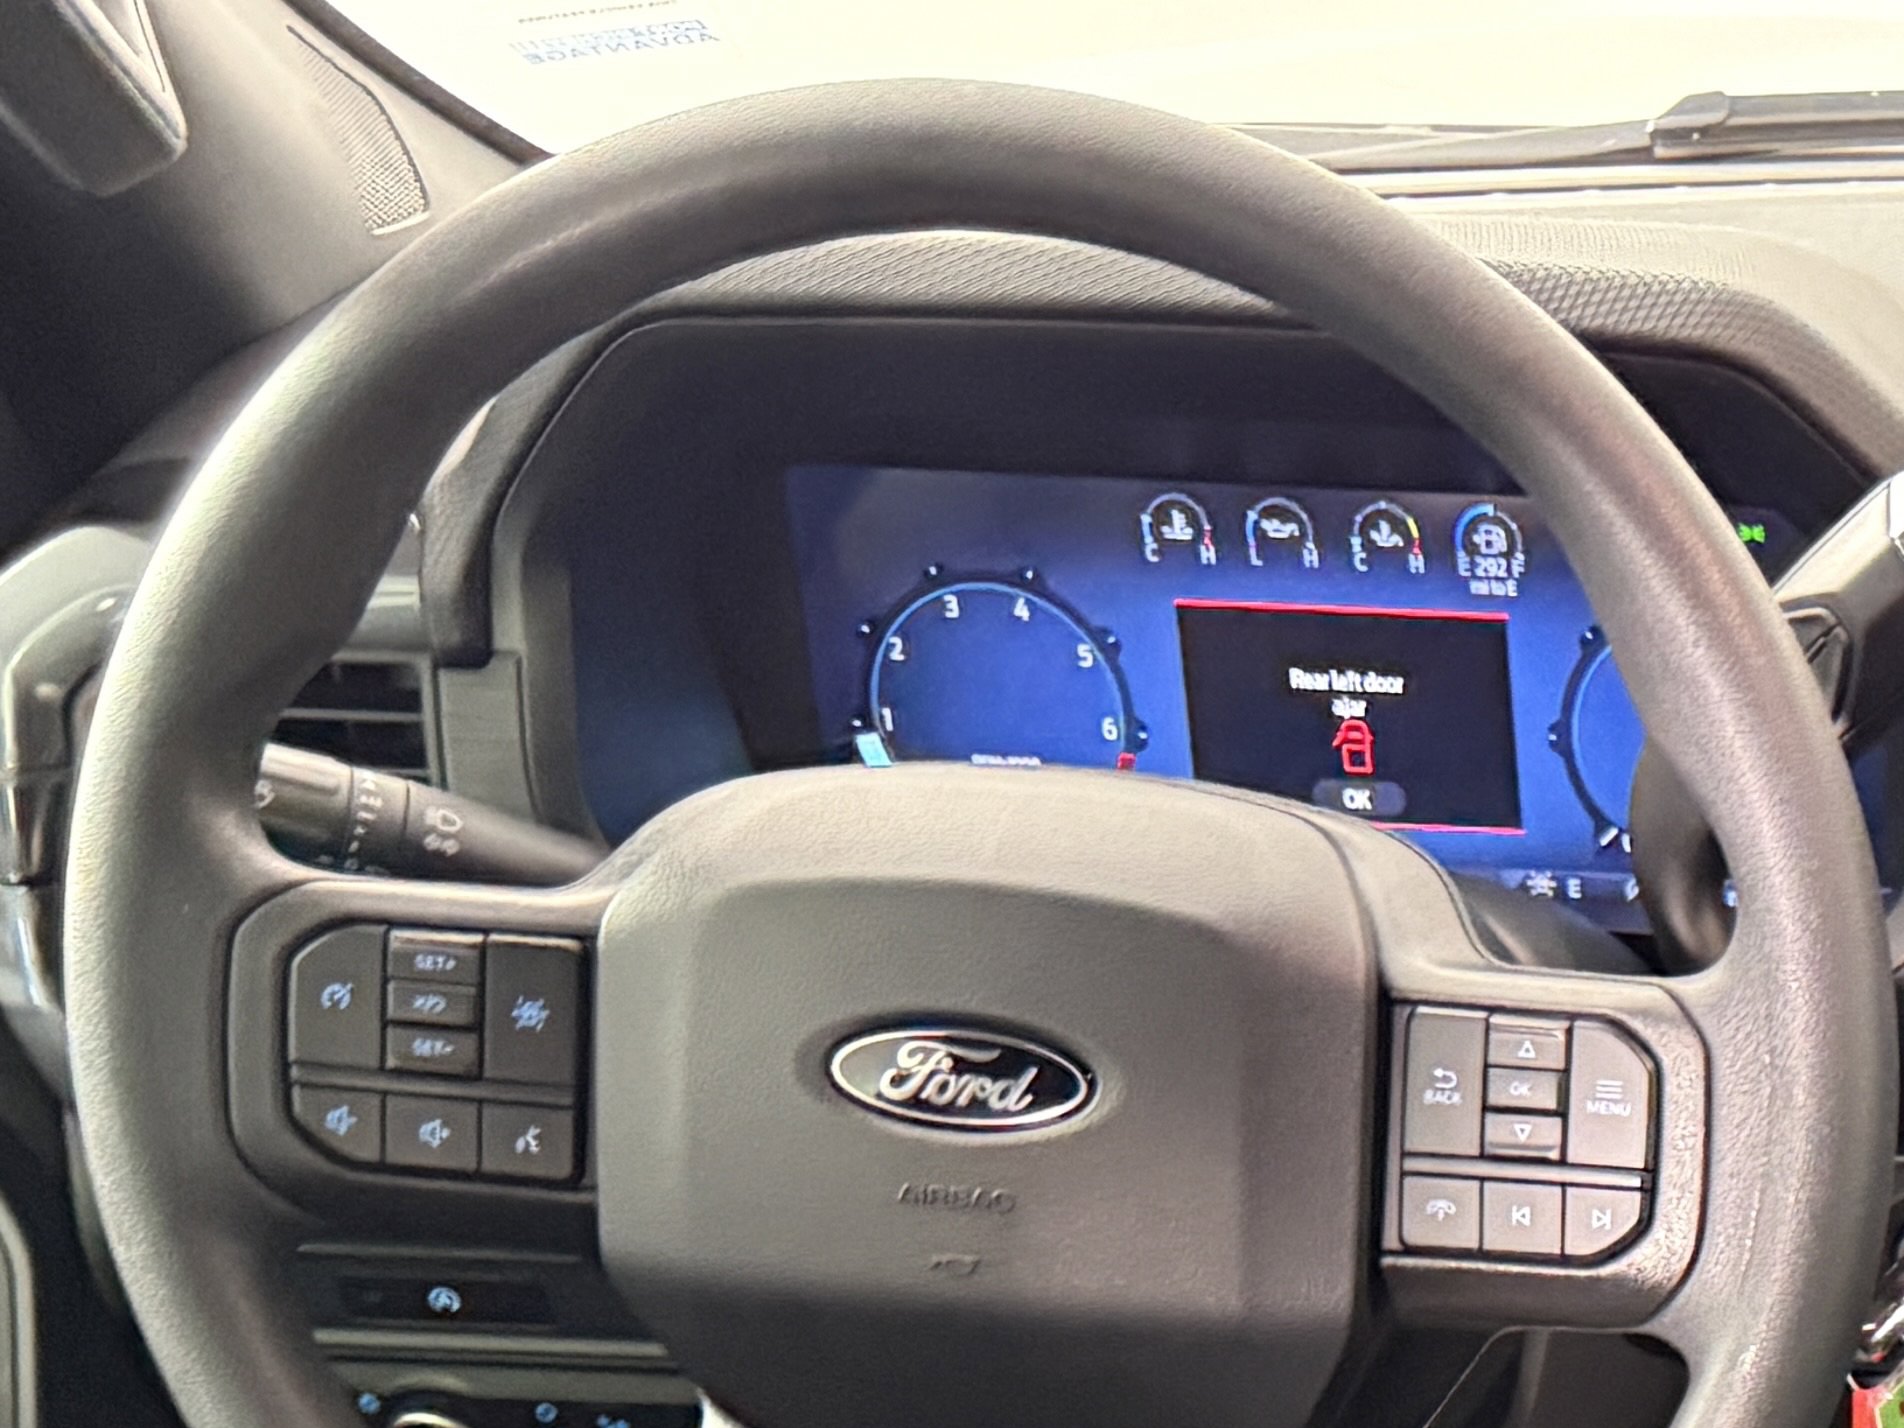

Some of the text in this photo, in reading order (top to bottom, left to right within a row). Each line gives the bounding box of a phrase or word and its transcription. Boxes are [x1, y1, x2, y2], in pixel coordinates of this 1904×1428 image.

[1145, 543, 1160, 563] C
[1200, 546, 1217, 566] H
[1249, 546, 1263, 566] L
[1303, 547, 1319, 568] H
[1353, 552, 1369, 572] C
[1409, 554, 1426, 574] H
[1474, 555, 1508, 577] 292
[943, 594, 960, 619] 3
[1013, 597, 1031, 621] 4
[888, 637, 905, 661] 2
[1077, 643, 1094, 668] 5
[1288, 667, 1404, 694] Rear left door
[880, 707, 894, 731] 1
[1331, 697, 1367, 719] ajar
[1101, 716, 1119, 741] 6
[1342, 788, 1373, 811] OK
[878, 1040, 1041, 1113] Ford
[1423, 1089, 1463, 1105] BACK
[1508, 1081, 1532, 1097] OK
[1586, 1102, 1632, 1117] MENU
[897, 1181, 1018, 1215] AIRBAG
